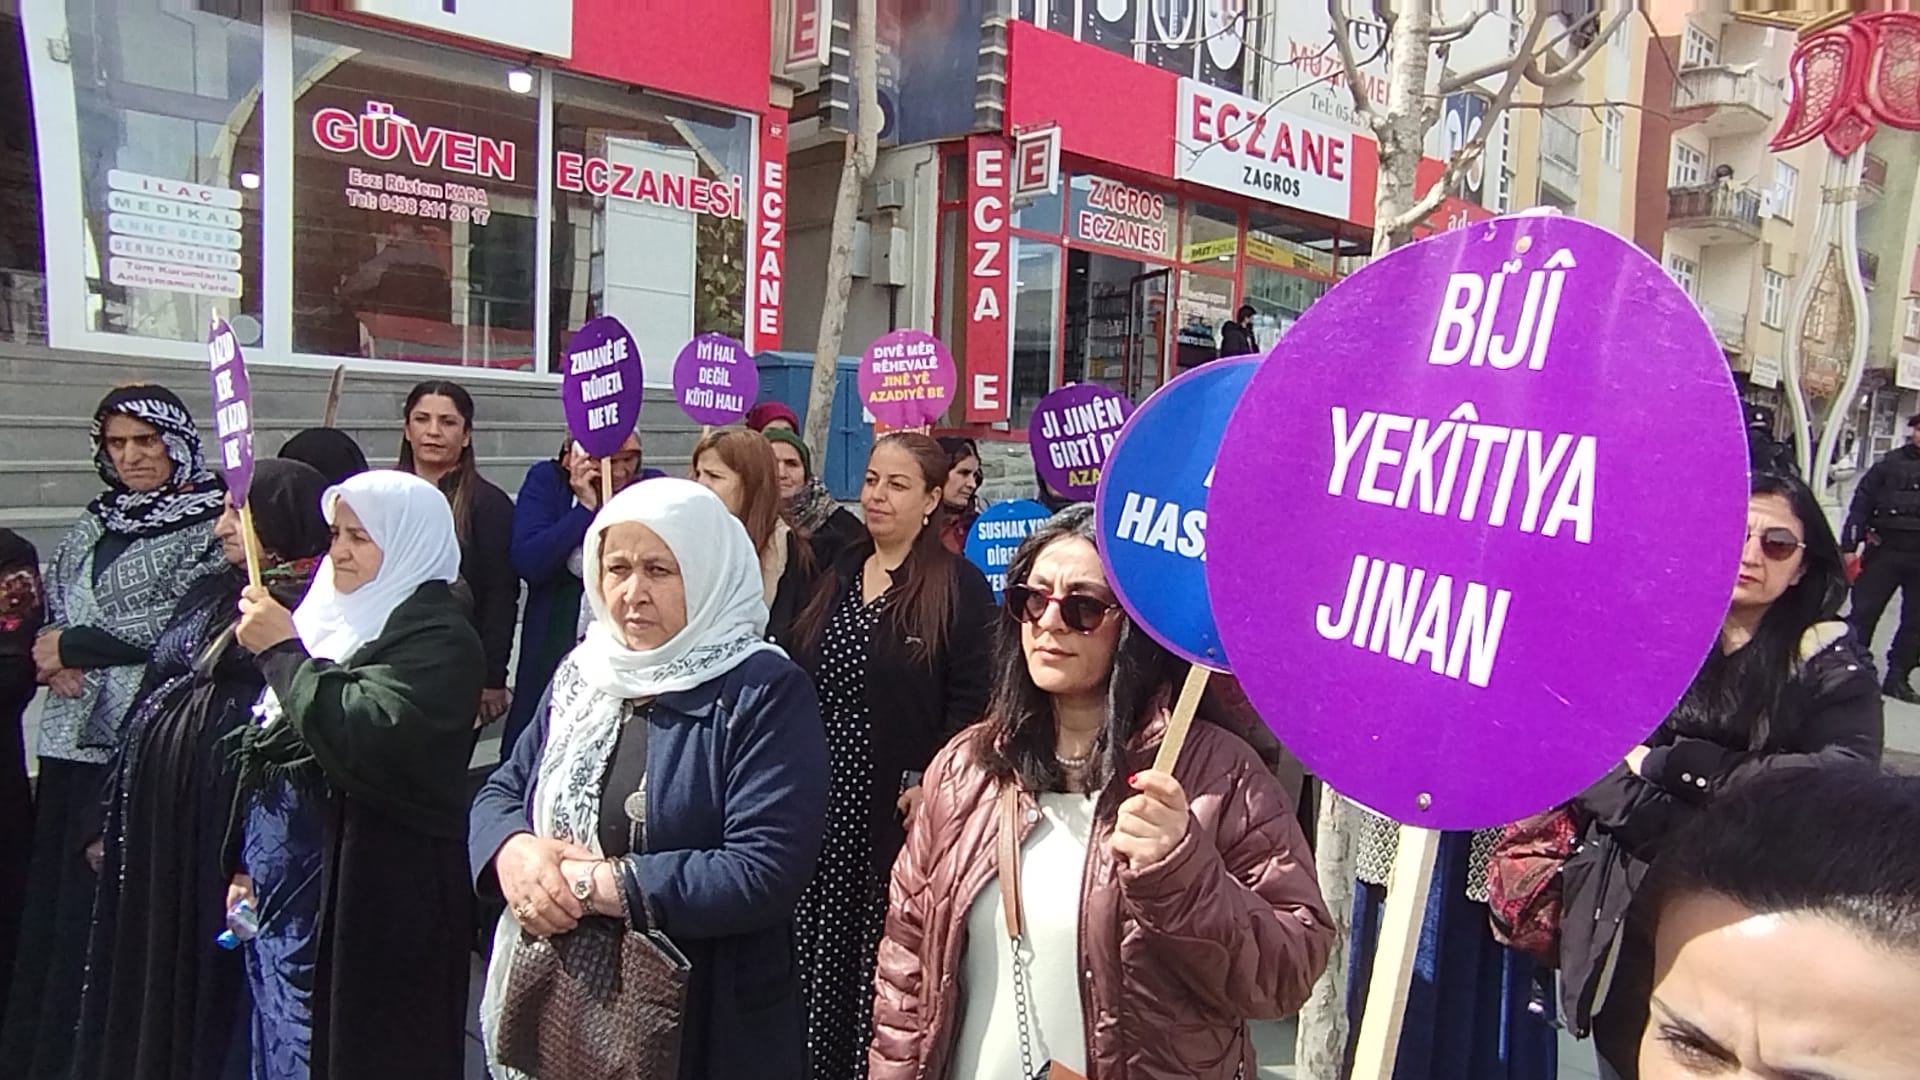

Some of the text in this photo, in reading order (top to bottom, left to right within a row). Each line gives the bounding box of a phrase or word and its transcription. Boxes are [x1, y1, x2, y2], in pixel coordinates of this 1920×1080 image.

[1310, 92, 1333, 116] Tel:
[313, 101, 515, 181] GÜVEN
[1192, 94, 1345, 181] ECZANE
[1025, 142, 1048, 183] E
[385, 173, 443, 198] Rüstem
[444, 182, 489, 206] KARA
[556, 151, 743, 219] ECZANESİ
[1243, 165, 1301, 198] ZAGROS
[345, 189, 378, 210] Tel:
[449, 206, 470, 223] 20
[1087, 179, 1163, 222] ZAGROS
[760, 162, 785, 335] ECZANE
[1079, 210, 1168, 254] ECZANESİ
[570, 338, 614, 375] ZIMANÊ
[713, 343, 737, 365] HAL
[698, 366, 732, 387] DEĞİL
[927, 385, 945, 399] BE
[684, 386, 714, 409] KÖTÜ
[1042, 395, 1124, 438] JI JINÊN
[1049, 432, 1100, 469] GIRTÎ
[1068, 468, 1101, 487] AZA
[1327, 402, 1597, 544] YEKÎTIYA
[978, 520, 1027, 540] SUSMAK
[1116, 491, 1207, 561] HAS
[1315, 554, 1511, 688] JINAN
